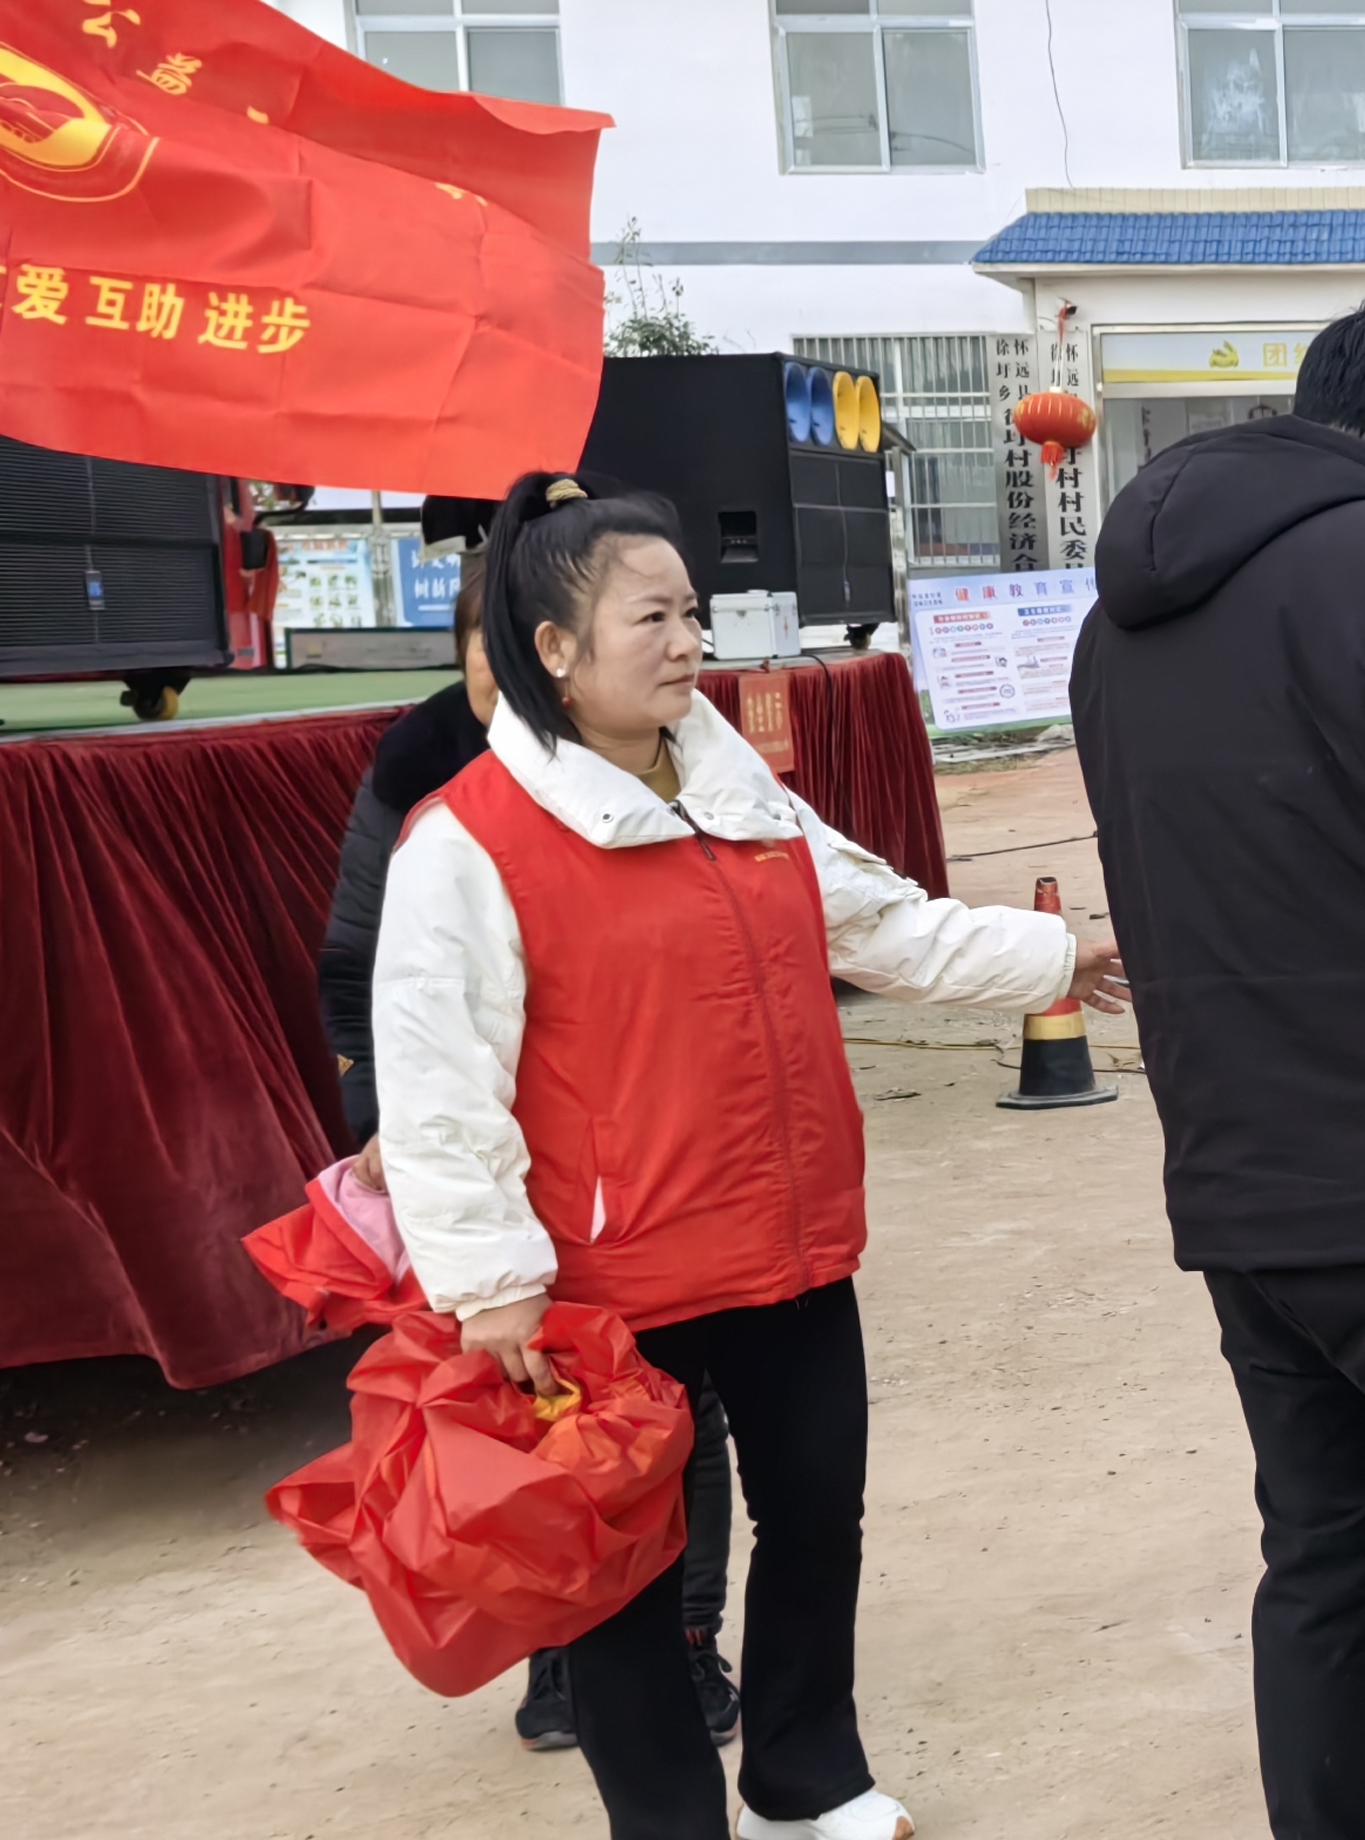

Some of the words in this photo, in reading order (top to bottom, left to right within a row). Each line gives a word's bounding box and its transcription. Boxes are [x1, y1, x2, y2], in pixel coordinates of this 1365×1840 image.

[0, 264, 69, 325] 爱
[85, 276, 184, 340] 互助
[197, 292, 311, 353] 进步
